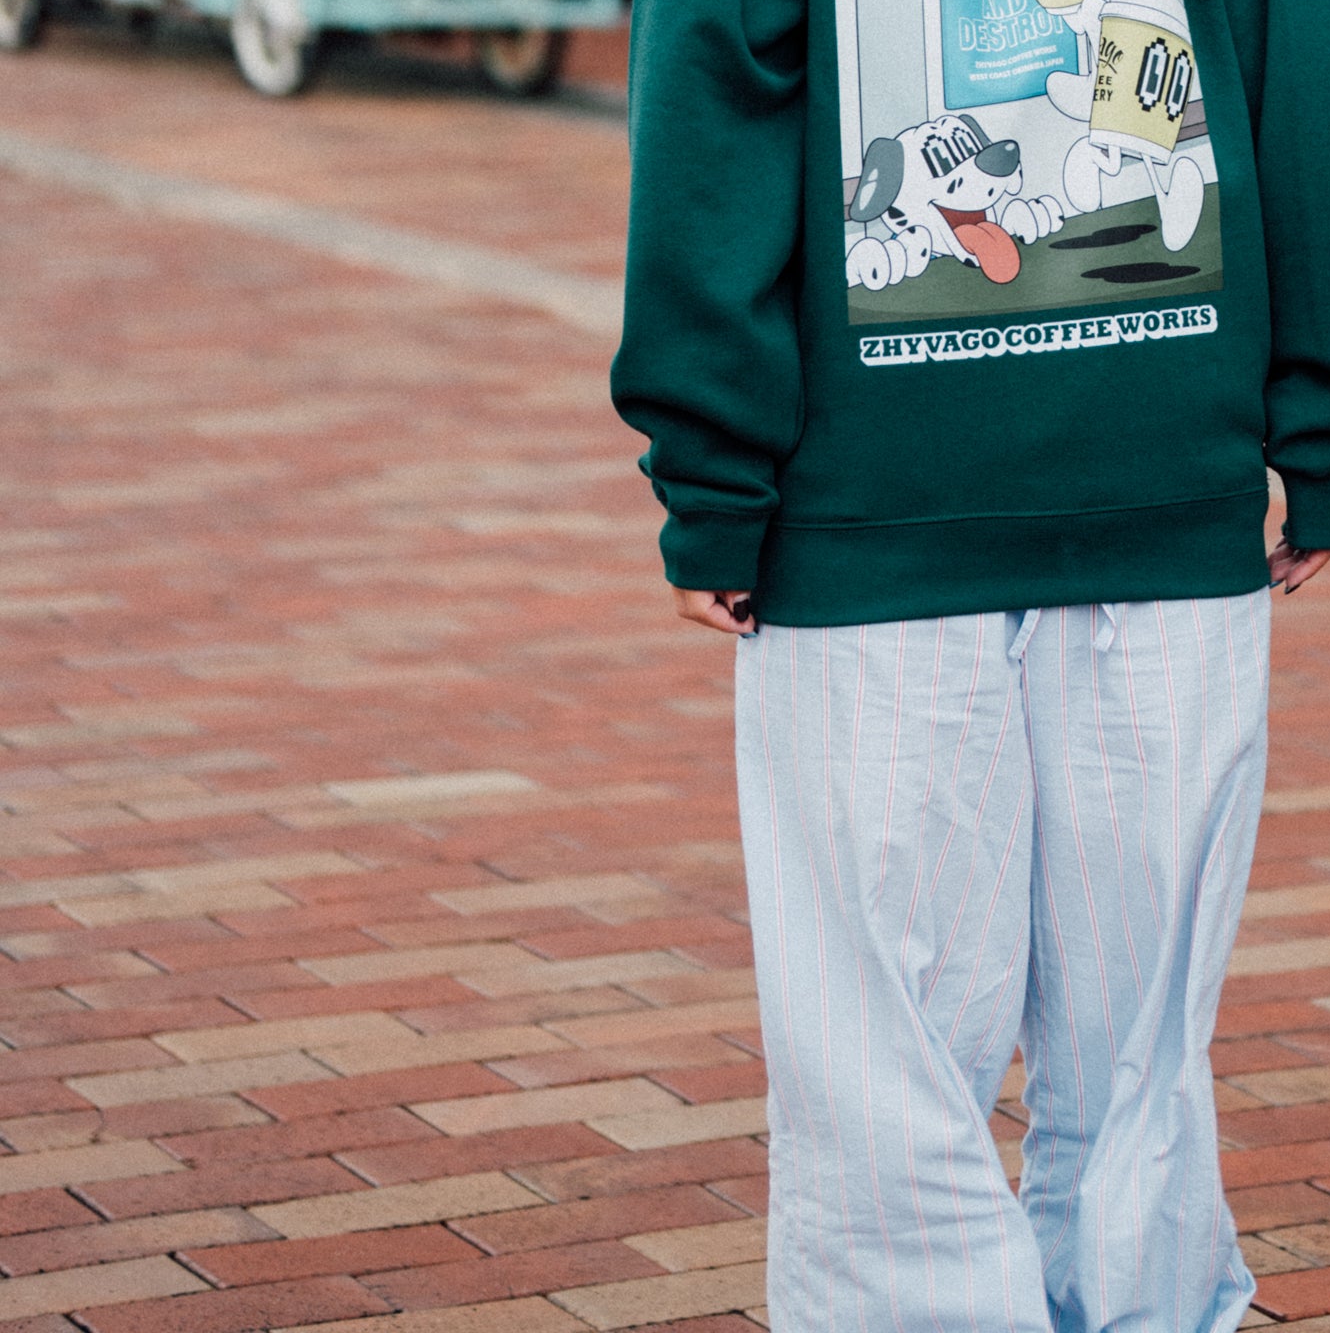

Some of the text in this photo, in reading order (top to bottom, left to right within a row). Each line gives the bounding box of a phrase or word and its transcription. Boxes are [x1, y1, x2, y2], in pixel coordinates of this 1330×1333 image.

[861, 307, 1214, 363] ZHYVAGO COFFEE WORKS
